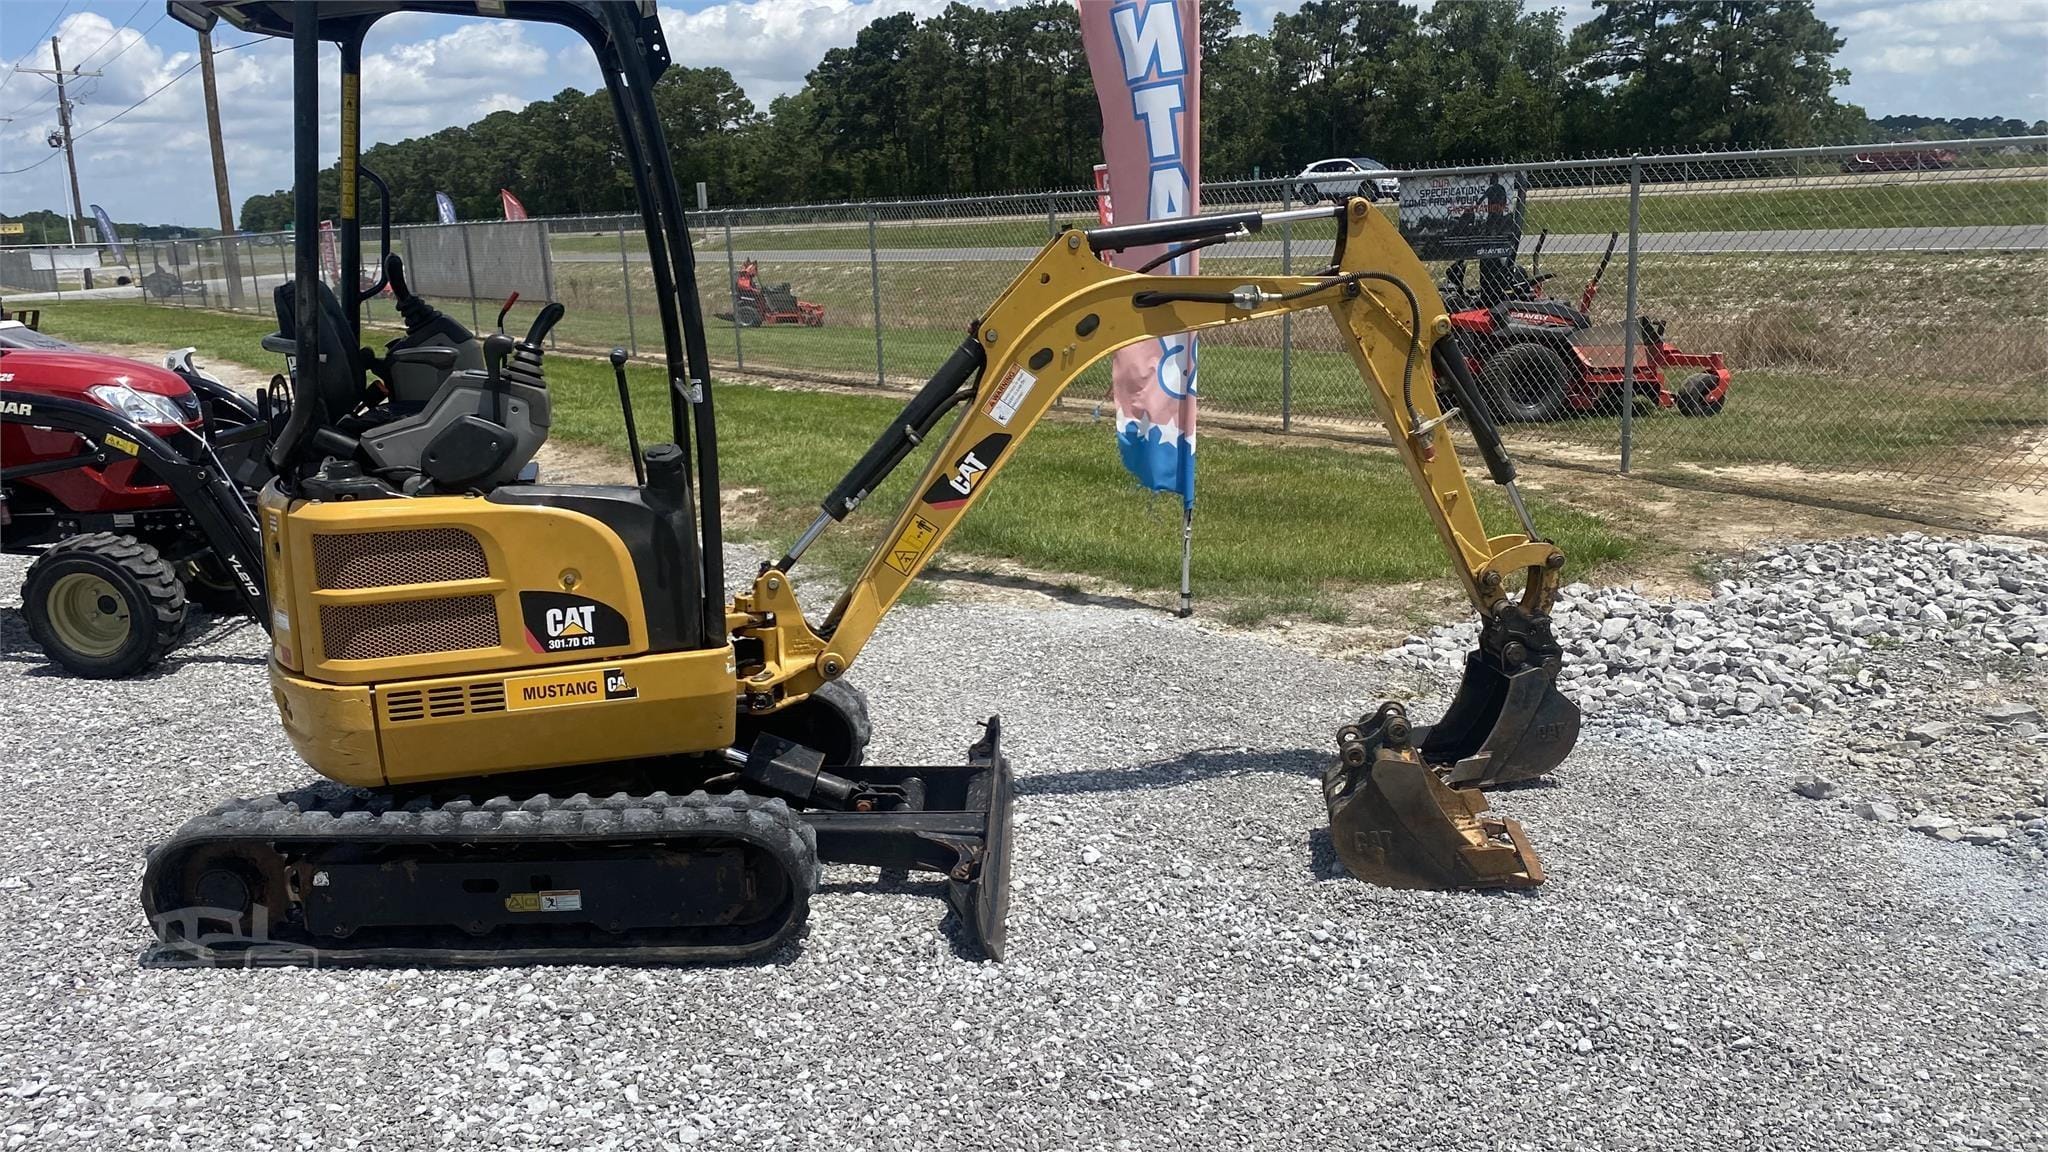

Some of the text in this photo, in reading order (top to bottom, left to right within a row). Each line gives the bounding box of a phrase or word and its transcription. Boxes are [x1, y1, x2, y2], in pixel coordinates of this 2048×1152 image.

[1404, 194, 1480, 208] COME FROM YOUR
[1420, 185, 1486, 198] SPECIFICATIONS
[1510, 311, 1549, 321] GRAVELY
[993, 372, 1015, 401] WARNING
[950, 451, 988, 495] CAT
[228, 554, 261, 596] YL210
[546, 605, 596, 637] CAT
[548, 636, 596, 650] 301.7D CR
[523, 676, 632, 701] MUSTANG CA
[1354, 830, 1393, 852] CAT
